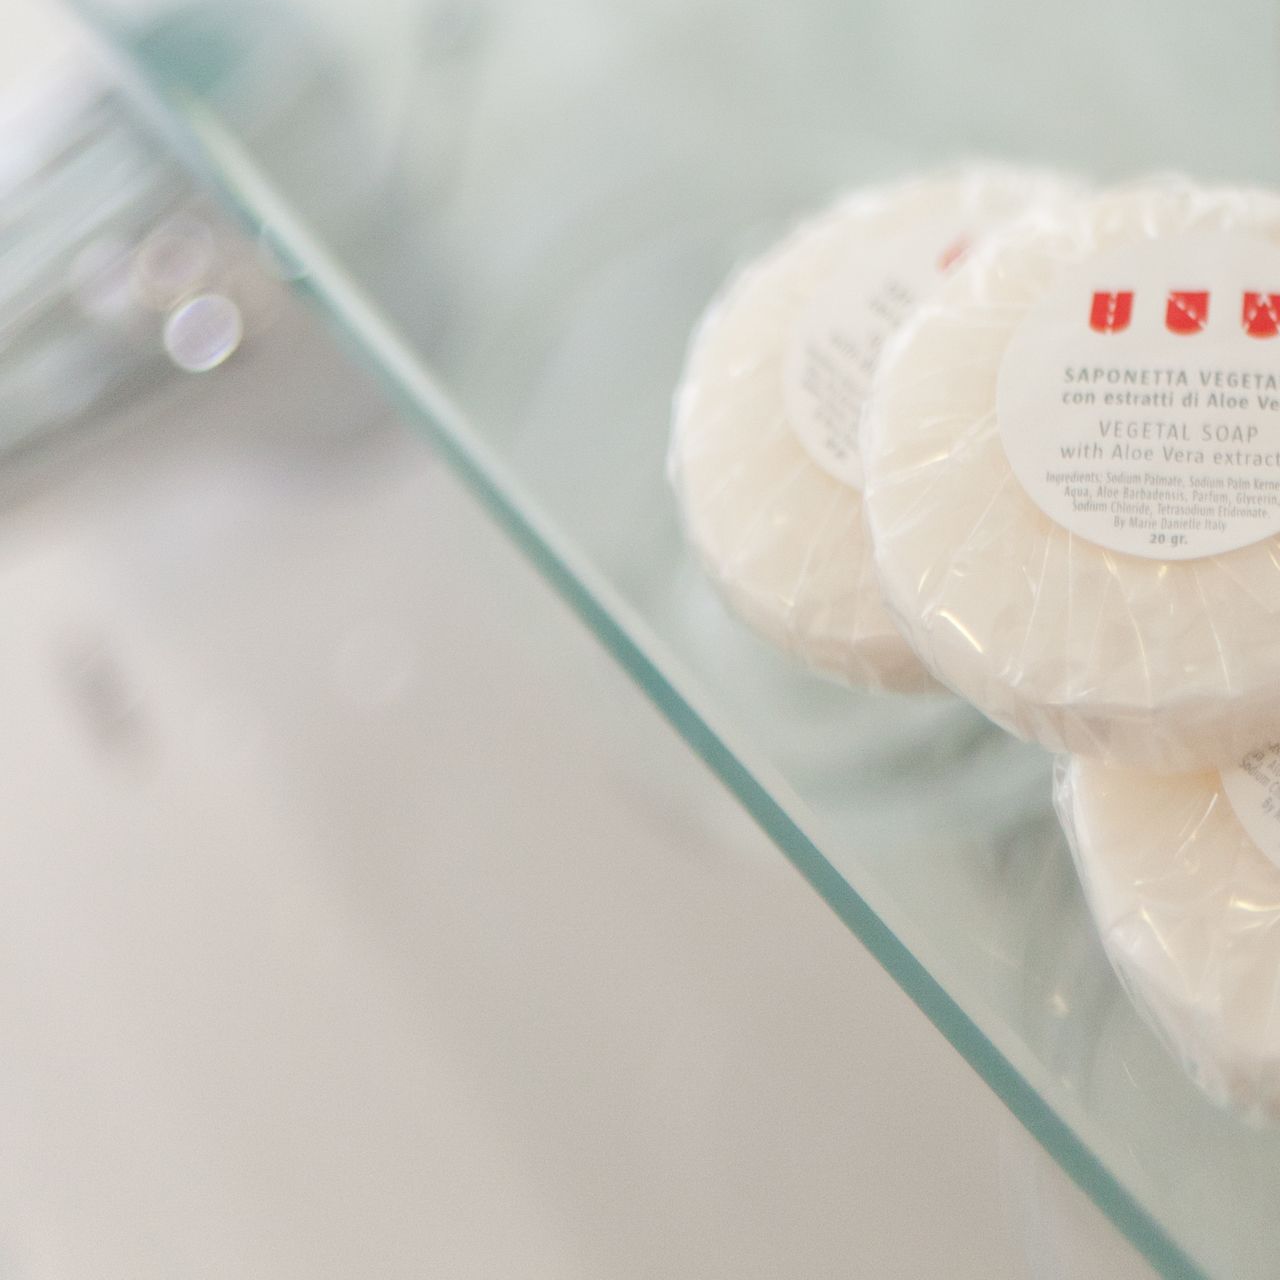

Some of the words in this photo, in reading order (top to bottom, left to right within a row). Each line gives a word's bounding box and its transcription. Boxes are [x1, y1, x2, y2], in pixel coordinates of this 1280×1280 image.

[1063, 366, 1188, 387] SAPONETTA
[1061, 391, 1096, 406] con
[1103, 390, 1174, 407] estratti
[1182, 391, 1199, 409] di
[1207, 393, 1249, 410] Aloe
[1098, 420, 1190, 441] VEGETAL
[1201, 423, 1259, 444] SOAP
[1060, 441, 1103, 459] with
[1111, 443, 1154, 461] Aloe
[1162, 445, 1204, 464] Vera
[1189, 475, 1224, 489] Sodium
[1227, 478, 1251, 490] Palm
[1097, 486, 1119, 498] Aloe
[1114, 516, 1125, 530] By
[1149, 533, 1166, 545] 20
[1169, 534, 1188, 547] gr.
